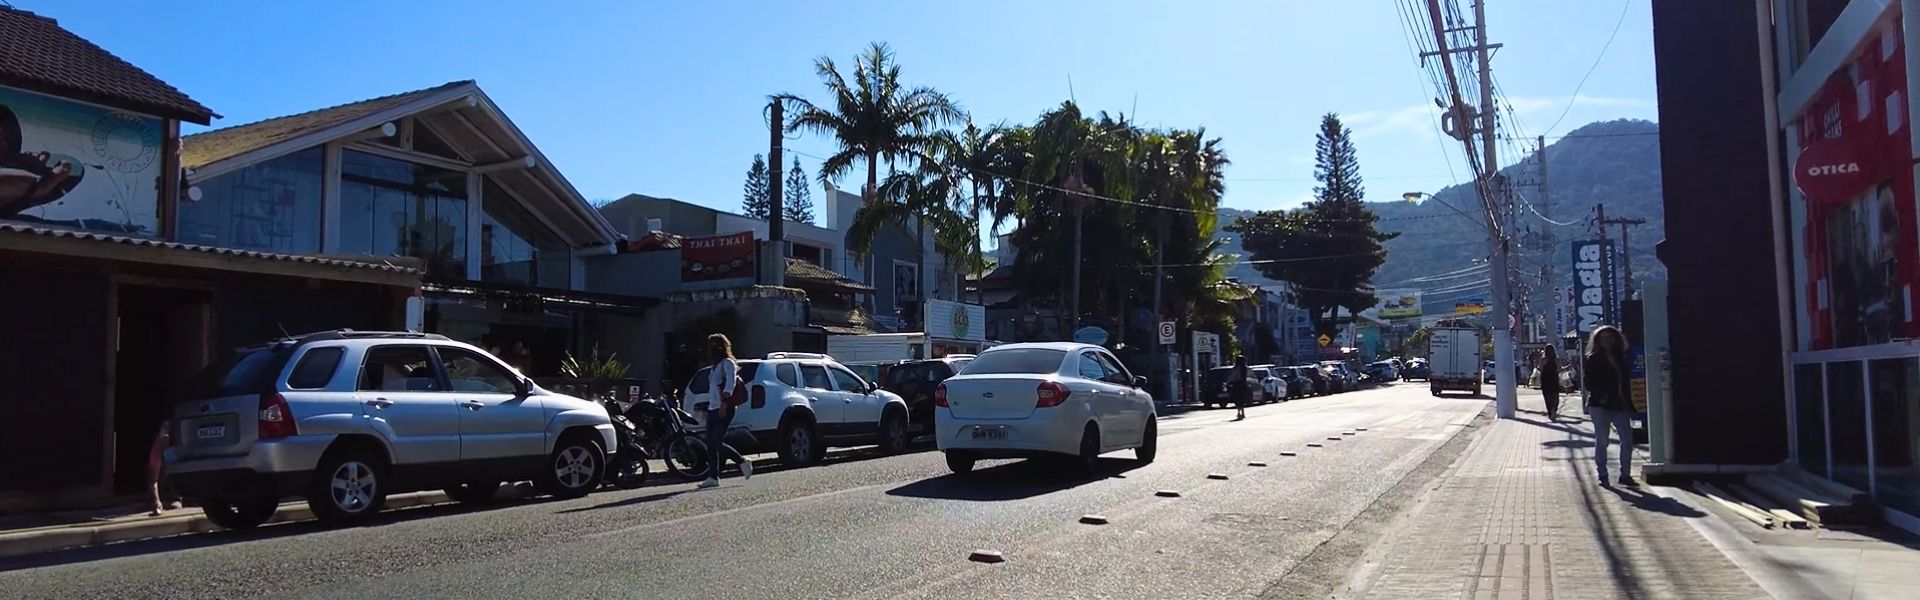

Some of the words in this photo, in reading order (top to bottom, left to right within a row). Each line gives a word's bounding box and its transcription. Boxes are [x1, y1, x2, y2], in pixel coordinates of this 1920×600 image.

[1808, 162, 1859, 176] ÓTICA
[689, 239, 715, 249] THAI
[719, 235, 746, 246] THAI
[1575, 244, 1604, 332] Magia
